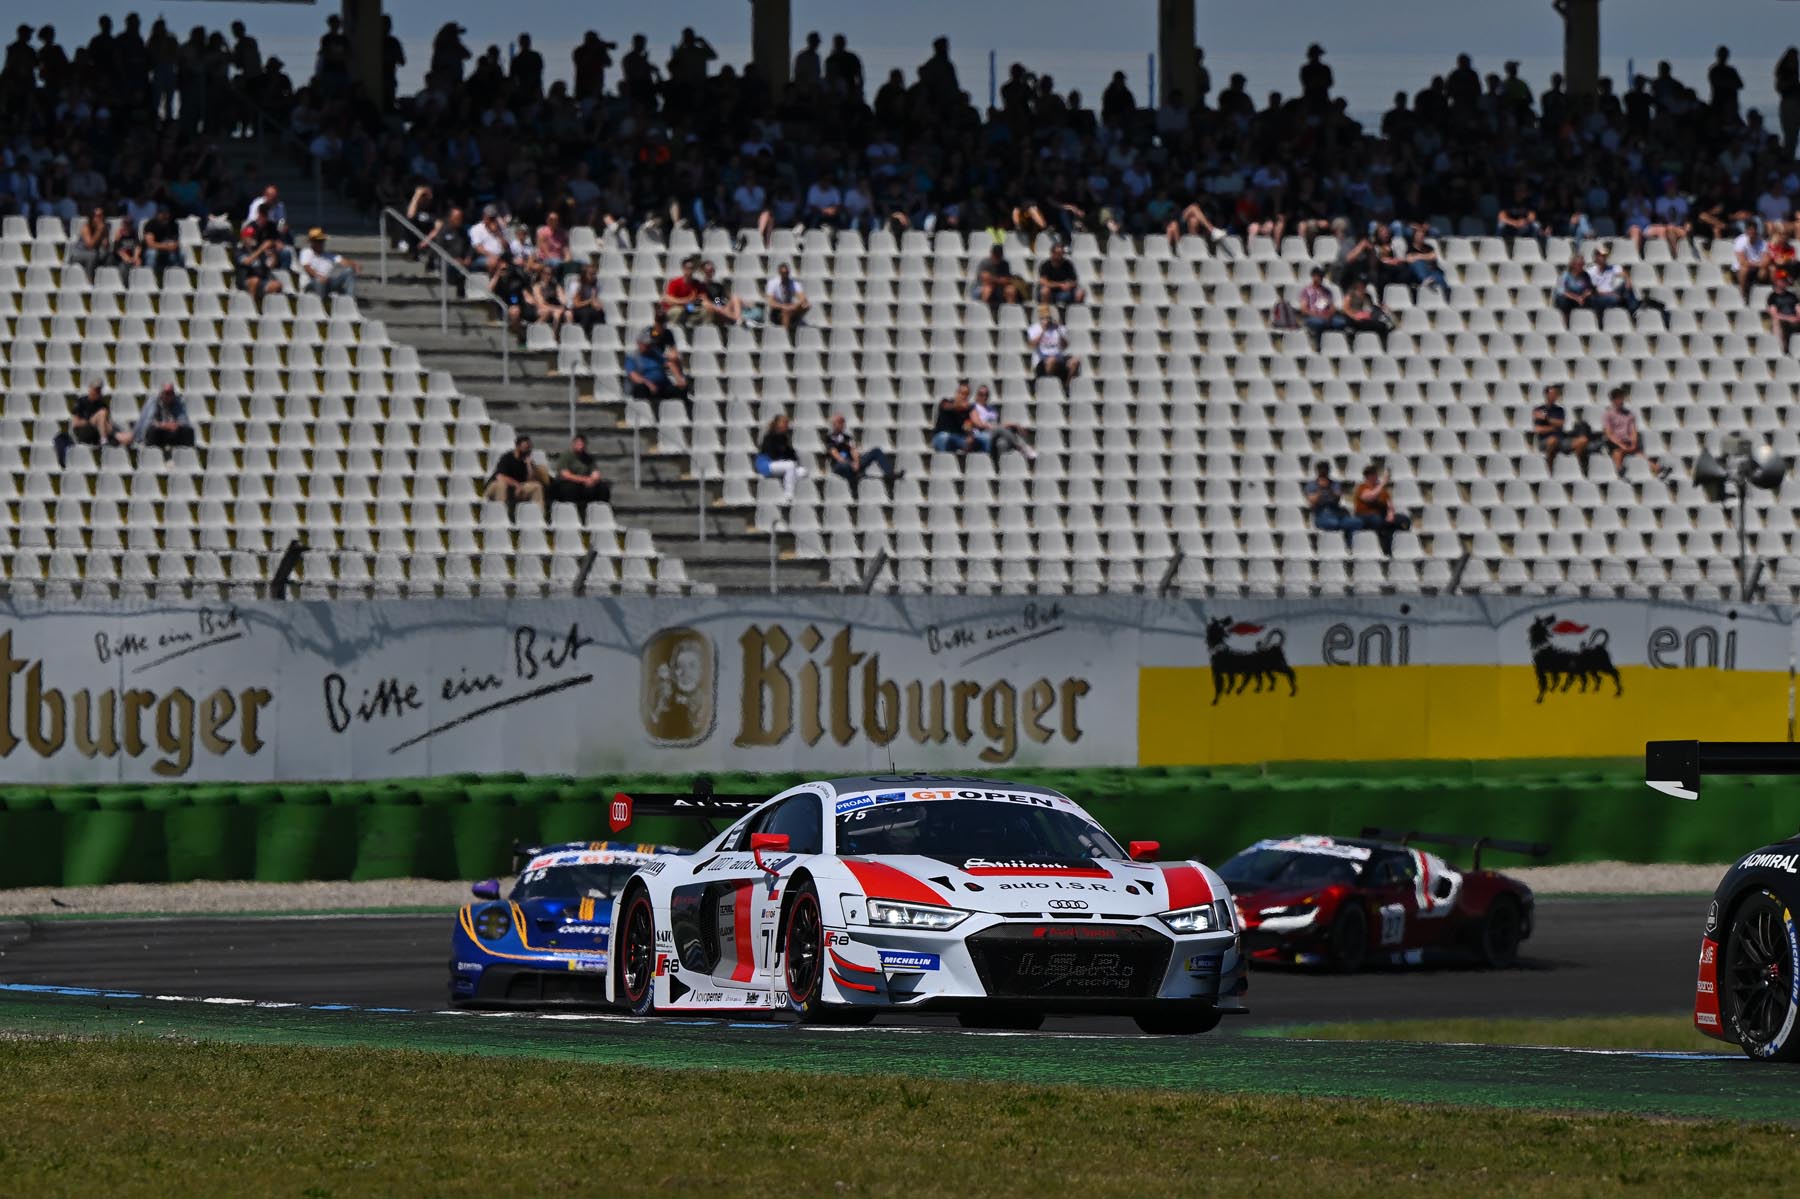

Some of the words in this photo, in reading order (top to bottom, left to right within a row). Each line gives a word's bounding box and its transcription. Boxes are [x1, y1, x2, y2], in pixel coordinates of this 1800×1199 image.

[1323, 603, 1409, 667] eni
[1648, 609, 1737, 670] eni
[324, 673, 423, 733] Bitte
[441, 666, 503, 700] ein
[514, 622, 594, 680] Bit
[733, 623, 1091, 764] Bitburger
[836, 797, 872, 811] PROAM
[842, 809, 867, 823] 75
[1738, 854, 1799, 873] ADMIRAL
[999, 881, 1049, 890] auto
[1055, 881, 1117, 893] I.S.R.
[829, 935, 850, 946] R8
[662, 959, 680, 974] R8
[884, 956, 931, 965] MICHELIN
[1789, 931, 1799, 1000] MICHELIN
